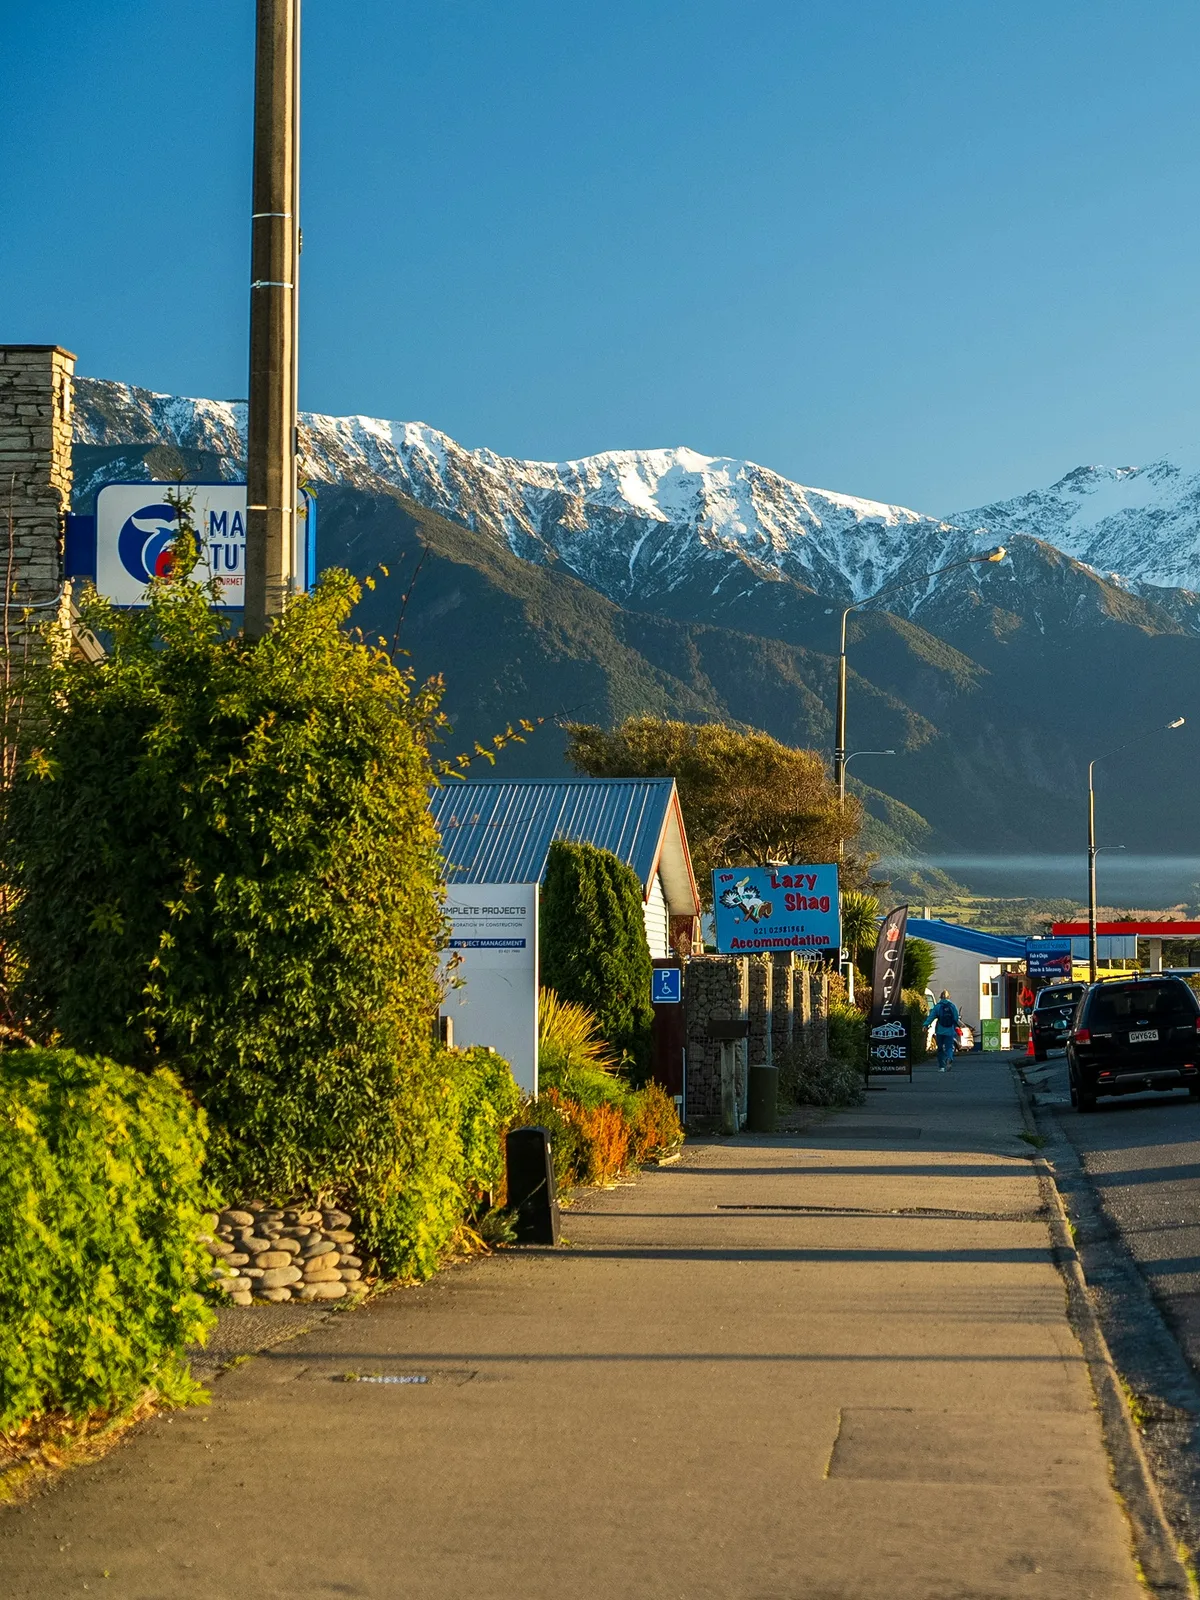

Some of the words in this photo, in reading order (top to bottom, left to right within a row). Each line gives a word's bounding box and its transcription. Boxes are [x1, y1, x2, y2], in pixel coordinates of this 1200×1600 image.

[215, 577, 244, 586] OURMET
[718, 873, 734, 883] The
[770, 873, 818, 891] Lazy
[784, 893, 831, 913] Shag
[439, 906, 479, 915] OMPLETE
[482, 906, 527, 915] PROJECTS
[730, 934, 830, 949] Accommodation
[661, 971, 671, 981] P
[881, 949, 898, 1016] CAFÉ
[1130, 1031, 1157, 1041] GWY626
[870, 1046, 907, 1059] HOUSE
